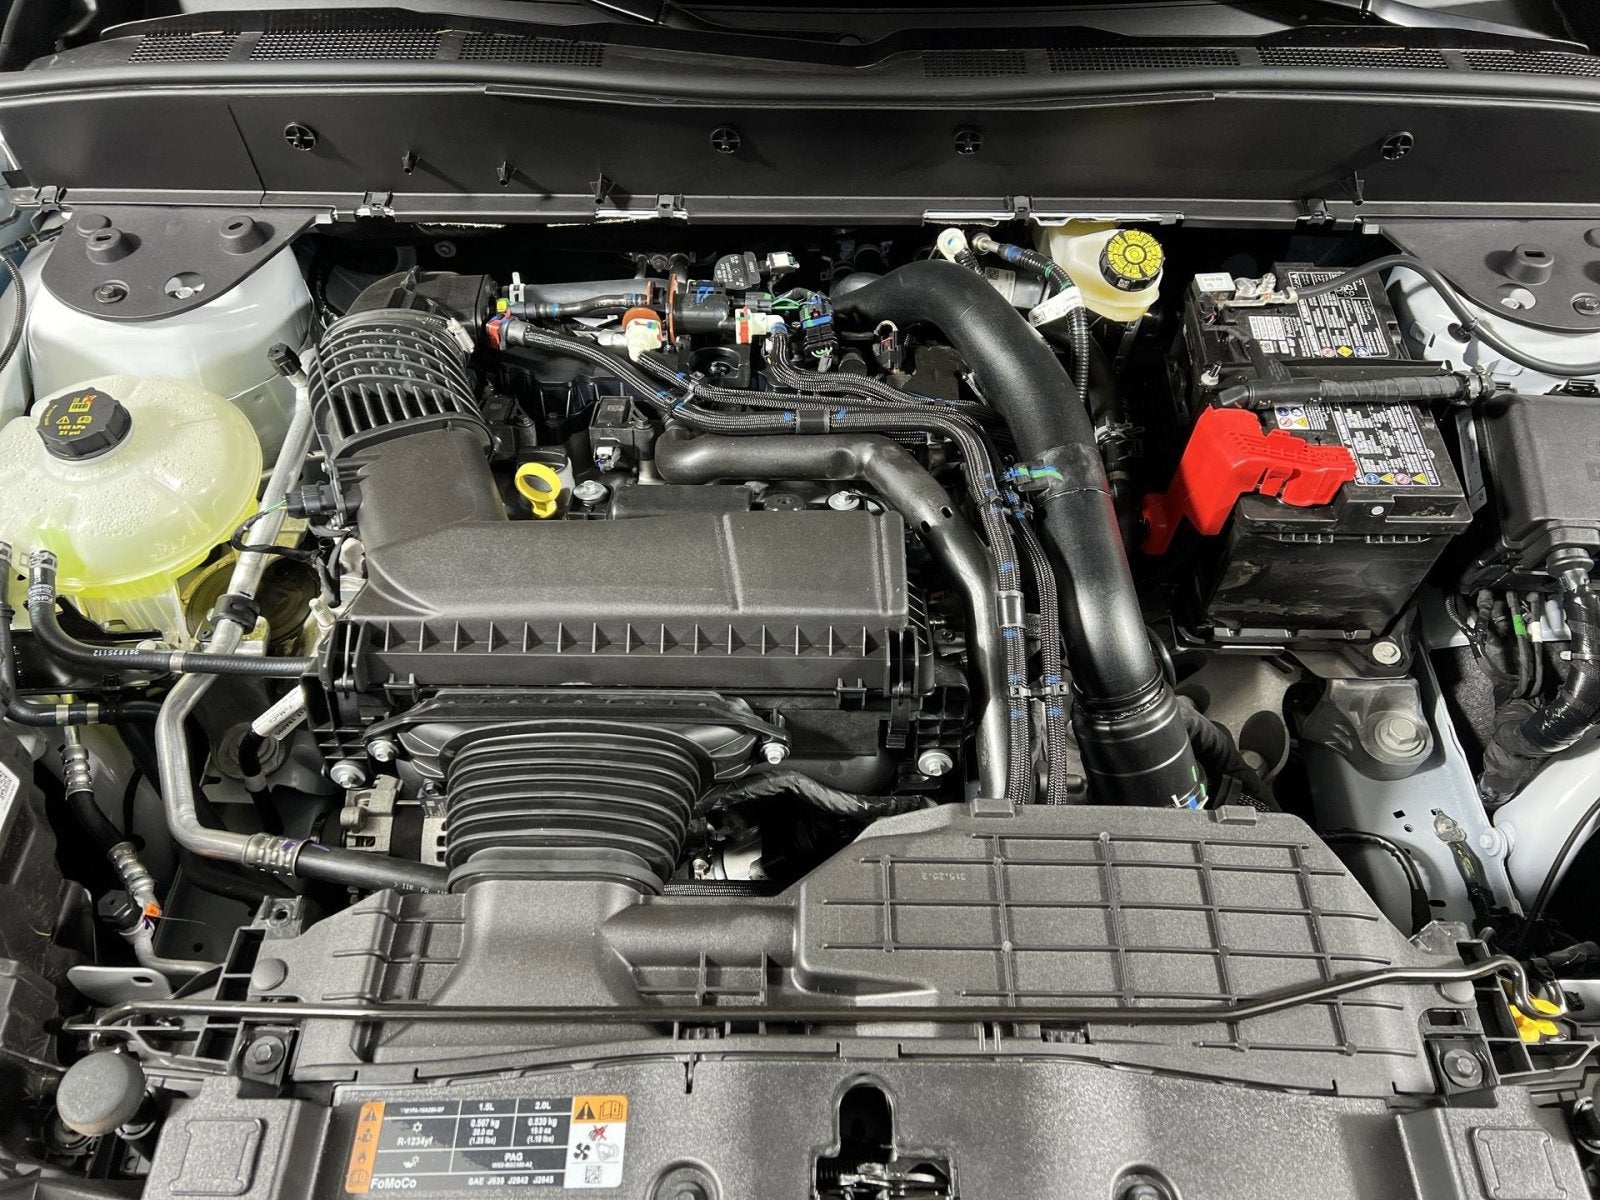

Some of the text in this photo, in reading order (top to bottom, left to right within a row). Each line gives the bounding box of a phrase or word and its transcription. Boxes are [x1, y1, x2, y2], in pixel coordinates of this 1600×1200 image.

[479, 1102, 495, 1111] 1.5L
[534, 1101, 551, 1110] 2.0L
[490, 1118, 500, 1129] kg
[547, 1116, 558, 1128] kg
[396, 1136, 434, 1148] R-1234yf
[504, 1152, 523, 1162] PAG
[370, 1177, 417, 1190] FoMoCo
[468, 1177, 484, 1186] SAE
